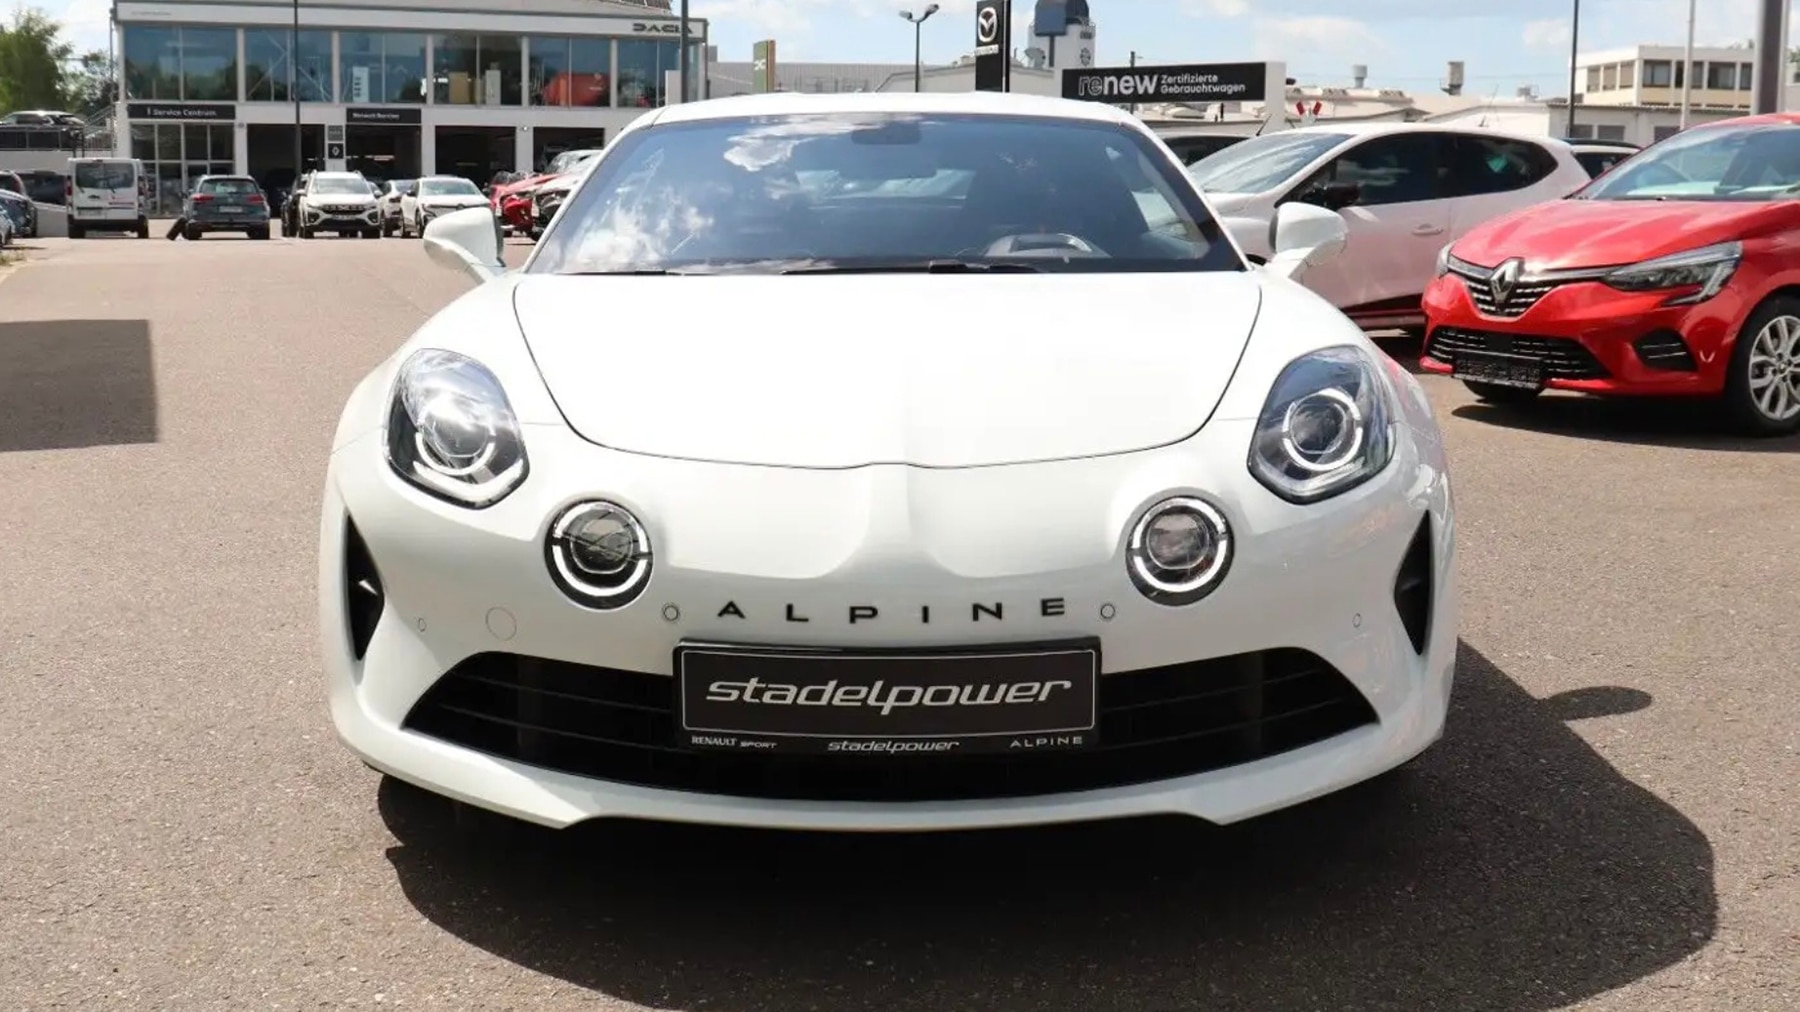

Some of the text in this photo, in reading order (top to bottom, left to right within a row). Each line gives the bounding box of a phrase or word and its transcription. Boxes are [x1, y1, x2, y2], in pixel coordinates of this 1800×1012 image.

[1078, 74, 1159, 96] renew
[1160, 73, 1219, 84] Zertifizierte
[1160, 83, 1246, 96] Gebrauchtwagen
[716, 598, 1065, 624] ALPINE
[705, 676, 1072, 716] stadelpower
[691, 735, 778, 749] RENAULT SPORT
[827, 739, 960, 754] stadelpower
[1009, 736, 1083, 749] ALPINE
